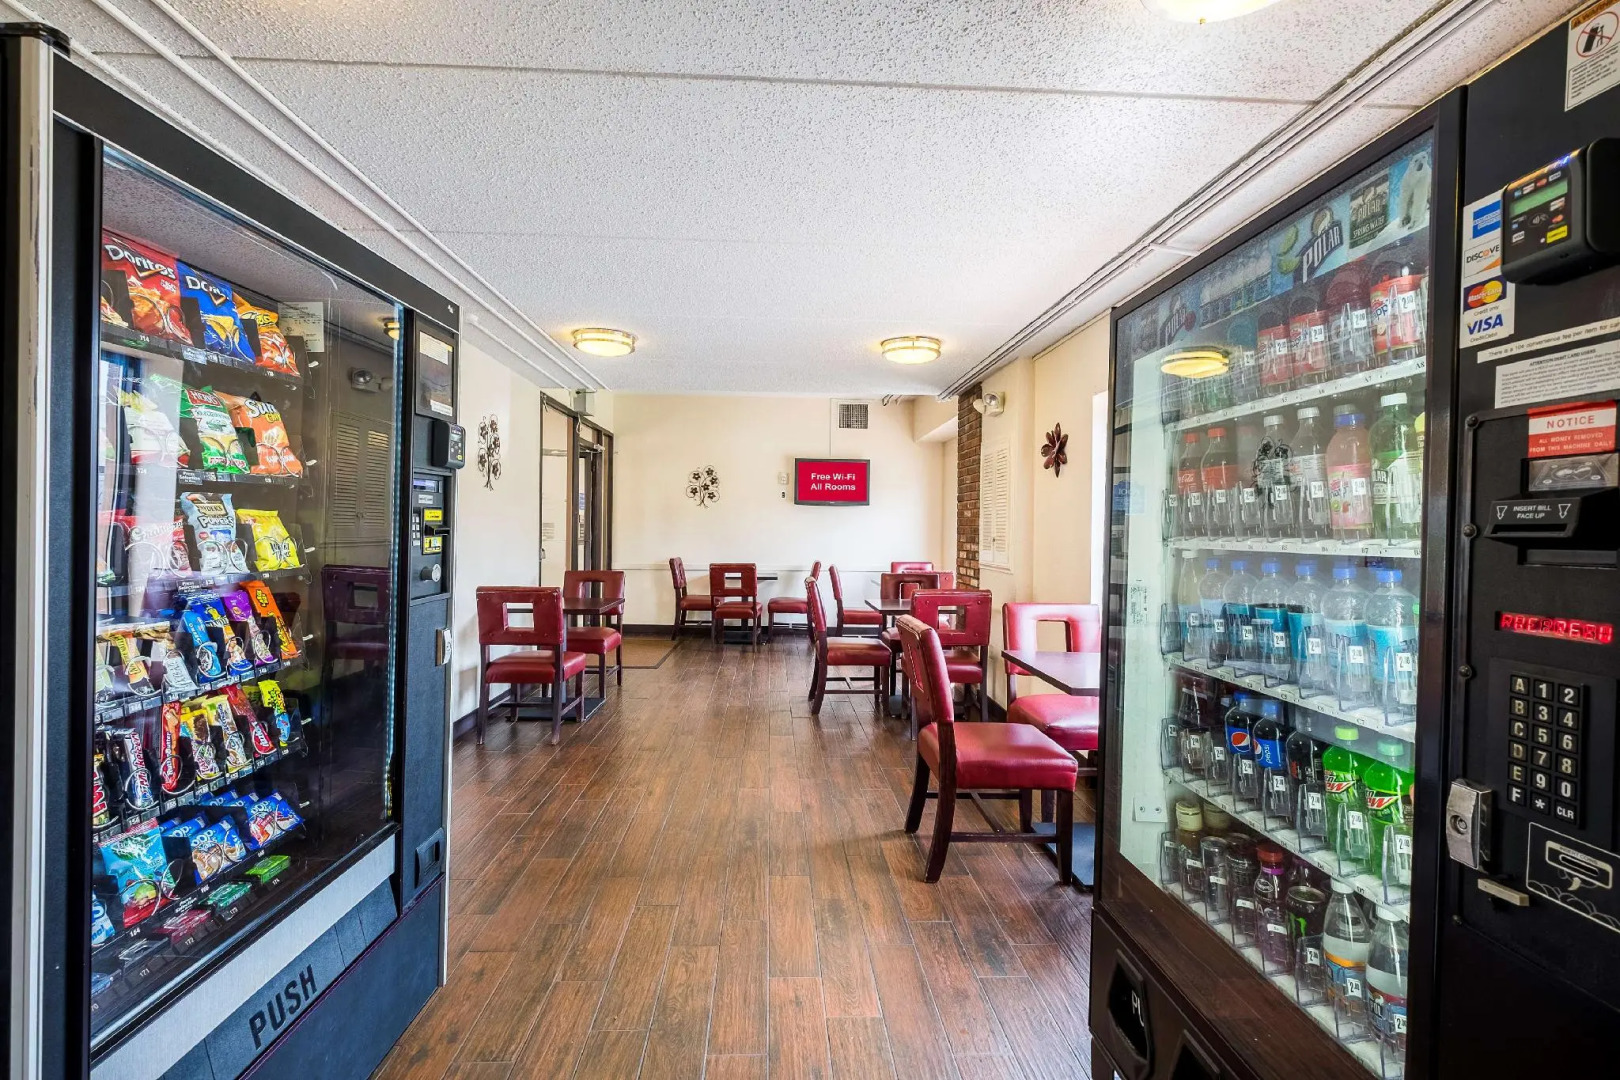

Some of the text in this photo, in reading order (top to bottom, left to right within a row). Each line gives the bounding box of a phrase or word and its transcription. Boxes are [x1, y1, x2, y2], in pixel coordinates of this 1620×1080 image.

[104, 244, 176, 280] Doritos
[1302, 226, 1341, 284] POLAR
[1466, 244, 1500, 264] DISCOVE
[1467, 313, 1503, 335] VISA
[1546, 415, 1595, 429] NOTICE
[1574, 432, 1603, 440] REMOVED
[810, 472, 856, 481] Free Wi-Fi
[824, 483, 856, 491] Rooms
[1515, 678, 1574, 704] A 1 2
[1515, 700, 1573, 728] B 3 4
[1514, 722, 1573, 750] C 5 6
[1264, 743, 1273, 766] pepsi
[1513, 743, 1572, 774] D 7 8
[1513, 765, 1571, 798] E 9 0
[1512, 787, 1521, 802] F
[1556, 806, 1574, 820] CLR
[184, 937, 195, 946] 172
[139, 968, 150, 978] 171
[249, 964, 317, 1050] PUSH
[1131, 990, 1145, 1027] PU
